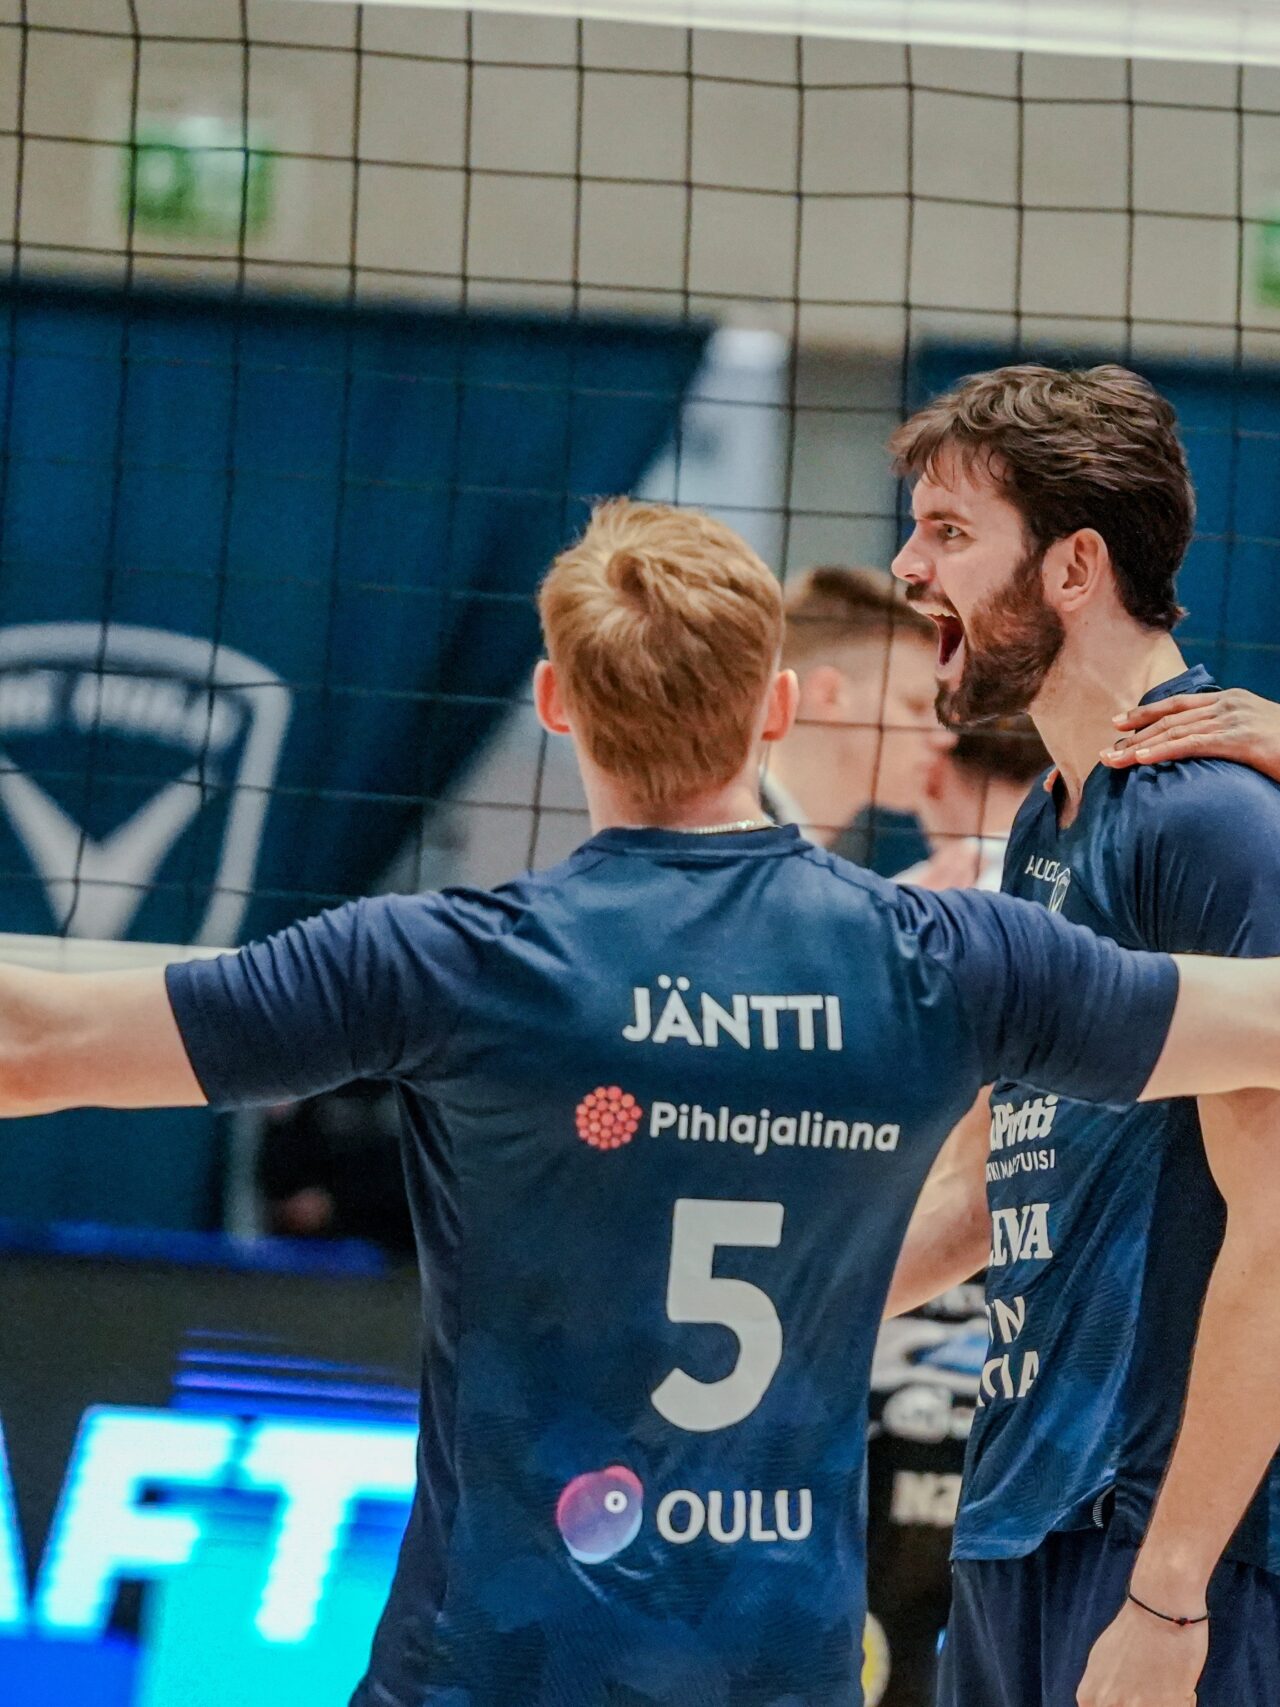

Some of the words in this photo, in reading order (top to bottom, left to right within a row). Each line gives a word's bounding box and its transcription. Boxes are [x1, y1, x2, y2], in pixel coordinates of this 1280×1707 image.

[622, 974, 843, 1051] JÄNTTI
[649, 1101, 900, 1155] Pihlajalinna
[990, 1094, 1058, 1152] Pirtti
[989, 1202, 1053, 1267] EVA
[651, 1198, 784, 1432] 5
[656, 1488, 813, 1544] OULU
